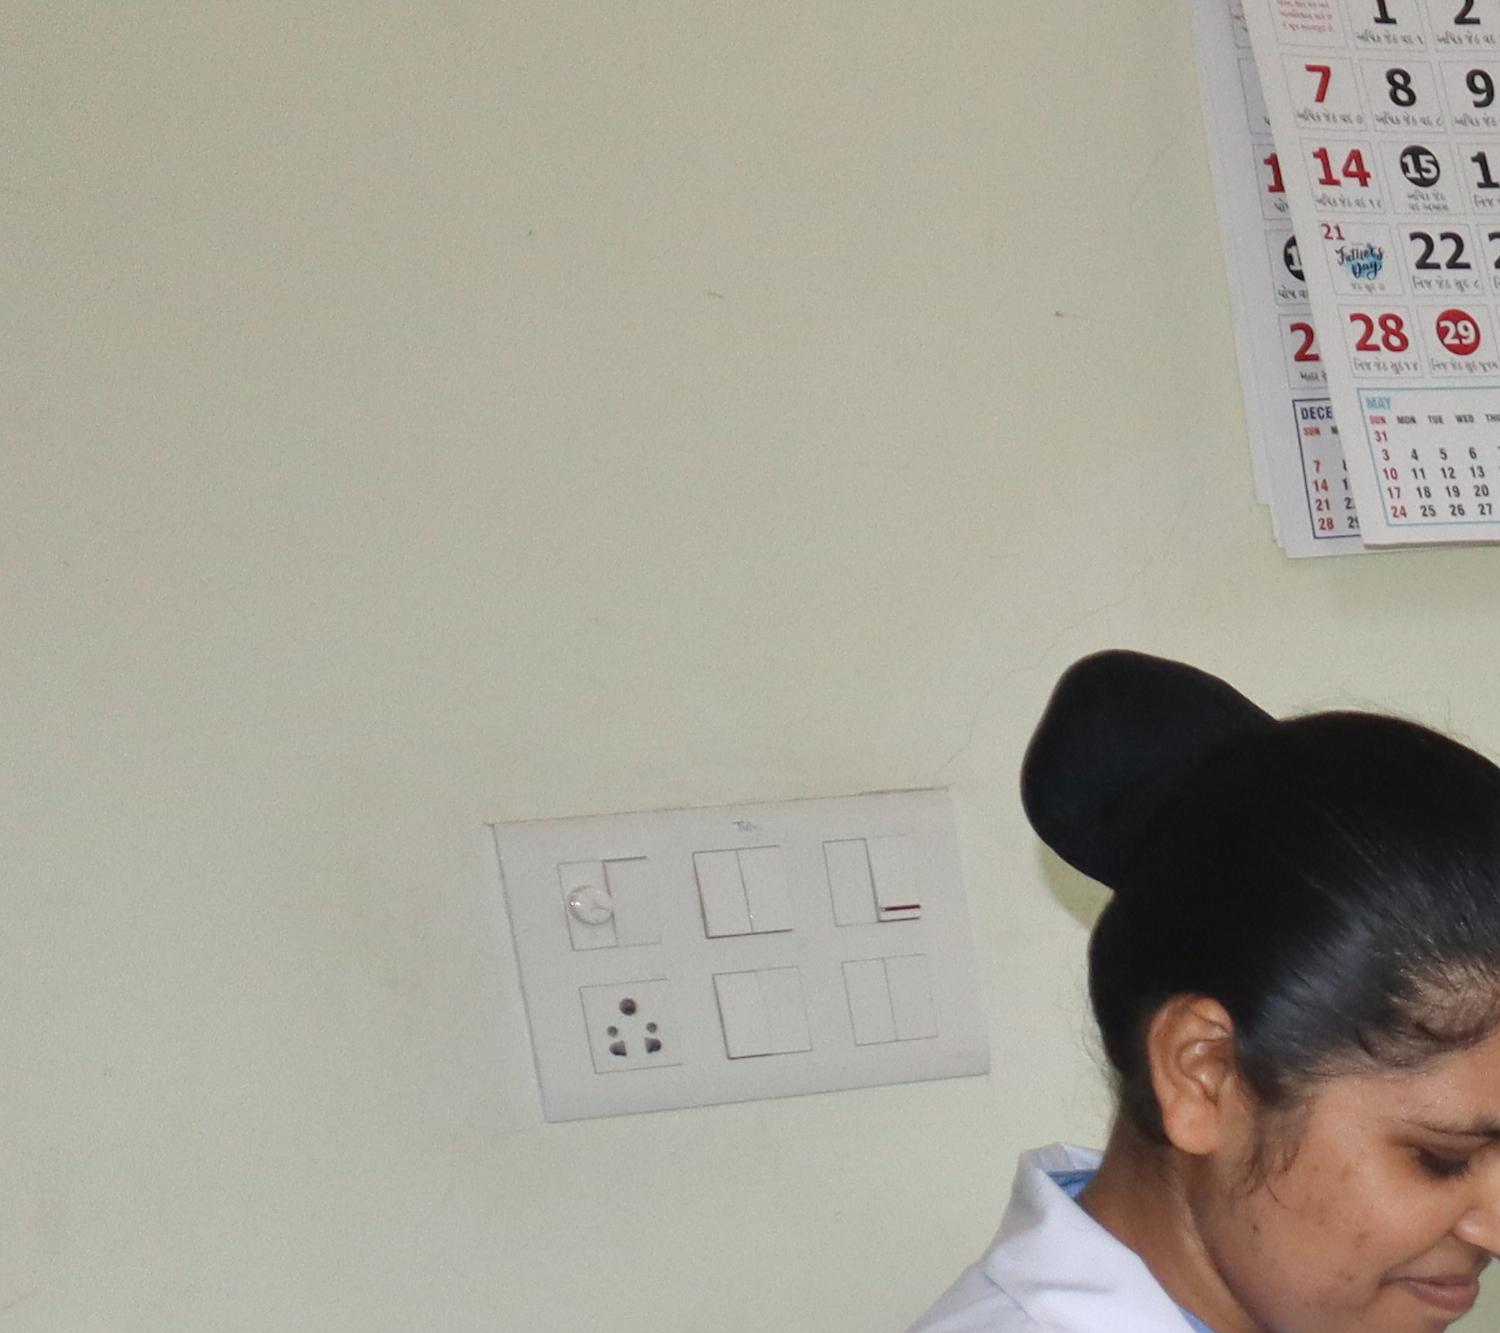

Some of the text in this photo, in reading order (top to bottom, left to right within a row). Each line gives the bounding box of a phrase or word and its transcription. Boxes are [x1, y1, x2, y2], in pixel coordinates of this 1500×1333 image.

[1373, 0, 1397, 25] 1
[1454, 0, 1481, 25] 2
[1305, 64, 1331, 103] 7
[1385, 68, 1416, 107] 8
[1466, 69, 1495, 108] 9
[1312, 147, 1371, 187] 14
[1401, 154, 1438, 178] 15
[1320, 223, 1345, 240] 21
[1409, 231, 1472, 270] 22
[1351, 256, 1382, 280] Day
[1349, 312, 1410, 353] 28
[1439, 319, 1476, 344] 29
[1366, 396, 1391, 410] MAY
[1375, 431, 1388, 442] 31
[1382, 450, 1390, 461] 3
[1410, 449, 1419, 460] 4
[1440, 449, 1447, 460] 5
[1469, 448, 1477, 459] 6
[1383, 468, 1398, 480] 10
[1411, 468, 1425, 479] 11
[1441, 468, 1456, 479] 12
[1470, 466, 1485, 478] 13
[1387, 487, 1401, 498] 17
[1417, 487, 1431, 498] 18
[1446, 486, 1460, 497] 19
[1474, 485, 1489, 496] 20
[1391, 507, 1407, 518] 24
[1421, 506, 1436, 517] 25
[1450, 505, 1465, 516] 26
[1479, 504, 1492, 515] 27
